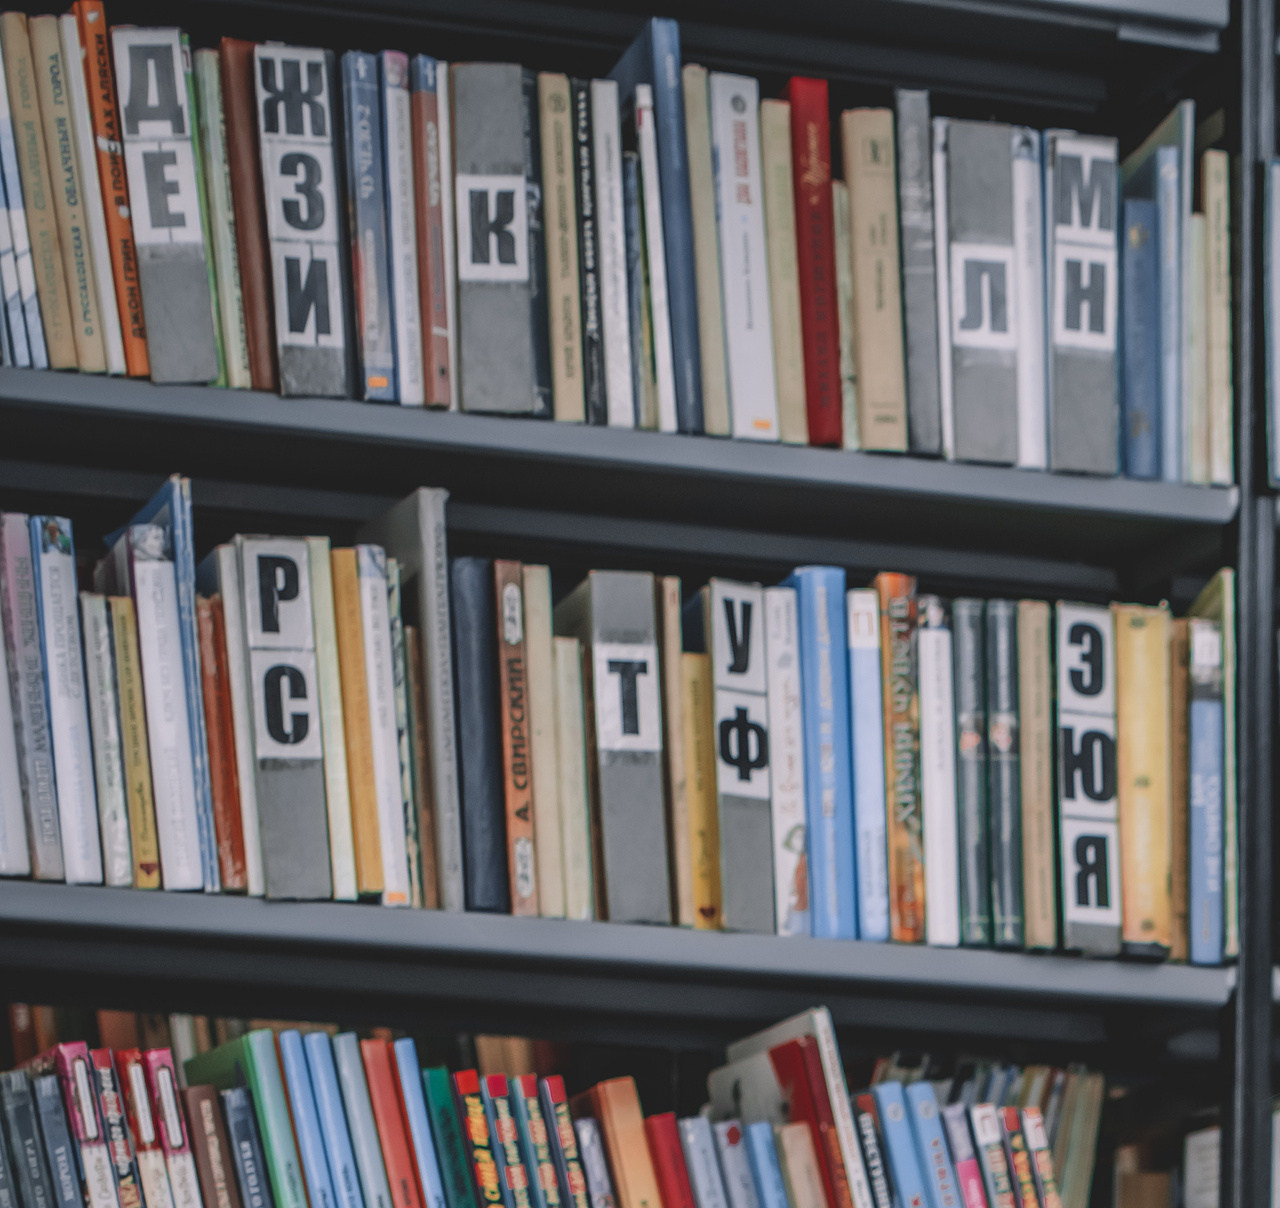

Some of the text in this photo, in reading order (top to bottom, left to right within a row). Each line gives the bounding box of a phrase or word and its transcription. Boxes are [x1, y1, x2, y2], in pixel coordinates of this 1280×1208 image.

[48, 52, 63, 105] ГОРОД
[94, 33, 112, 104] АЛЯСКИ
[124, 45, 188, 136] Д
[260, 57, 331, 135] Ж
[55, 117, 77, 207] ОБЛАЧНЫЙ
[143, 150, 186, 228] Е
[280, 152, 325, 230] З
[1056, 154, 1114, 230] М
[119, 239, 136, 283] ГРИН
[469, 189, 516, 264] К
[127, 287, 146, 340] ДЖОН
[285, 256, 331, 336] И
[960, 259, 1008, 333] Л
[1065, 260, 1106, 334] Н
[257, 555, 299, 633] Р
[721, 600, 751, 673] У
[1068, 623, 1105, 695] Э
[264, 664, 308, 745] С
[607, 659, 648, 736] Т
[720, 707, 769, 781] Ф
[1063, 728, 1116, 802] Ю
[1075, 834, 1110, 908] Я
[930, 1139, 954, 1207] ПТИЦА
